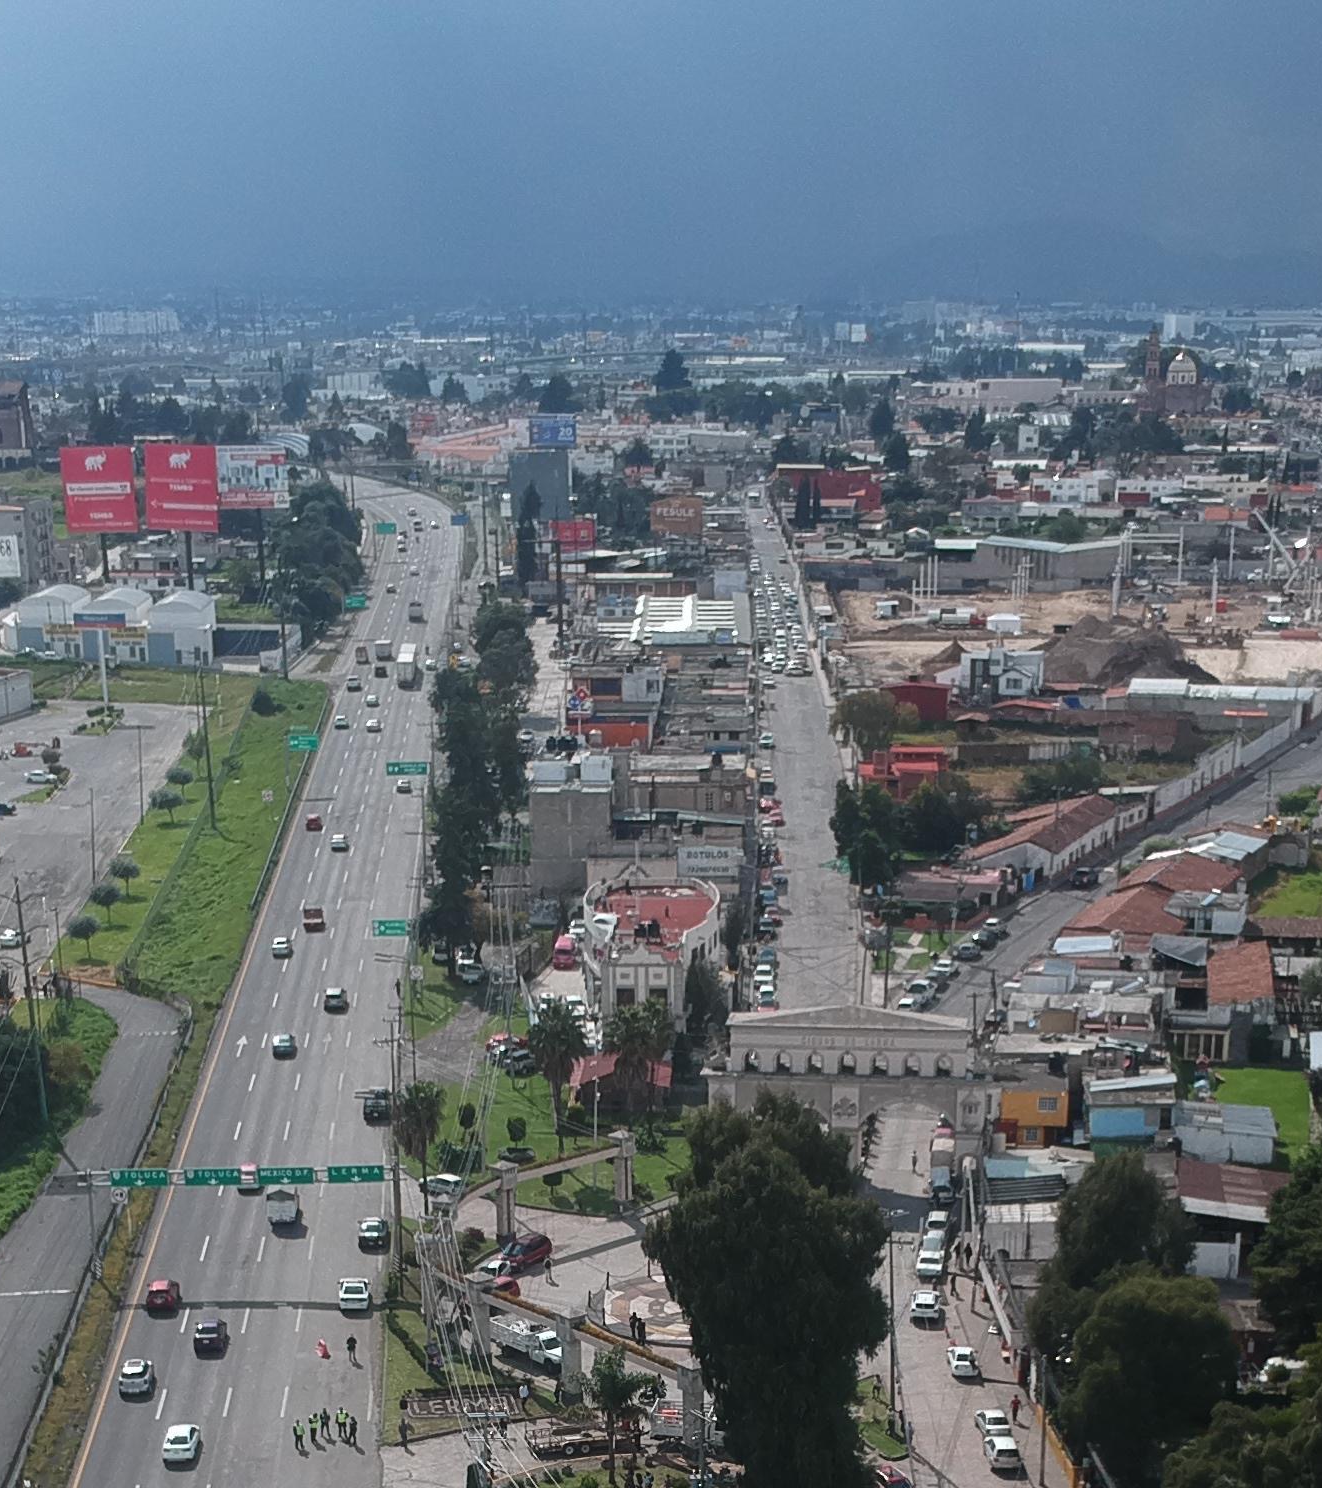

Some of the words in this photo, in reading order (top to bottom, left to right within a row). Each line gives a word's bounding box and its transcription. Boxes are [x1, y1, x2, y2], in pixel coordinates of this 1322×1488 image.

[124, 1171, 166, 1179] TOLUCA
[198, 1170, 239, 1178] TOLUCA
[331, 1167, 380, 1176] LERMA
[413, 1397, 510, 1415] LERMA
